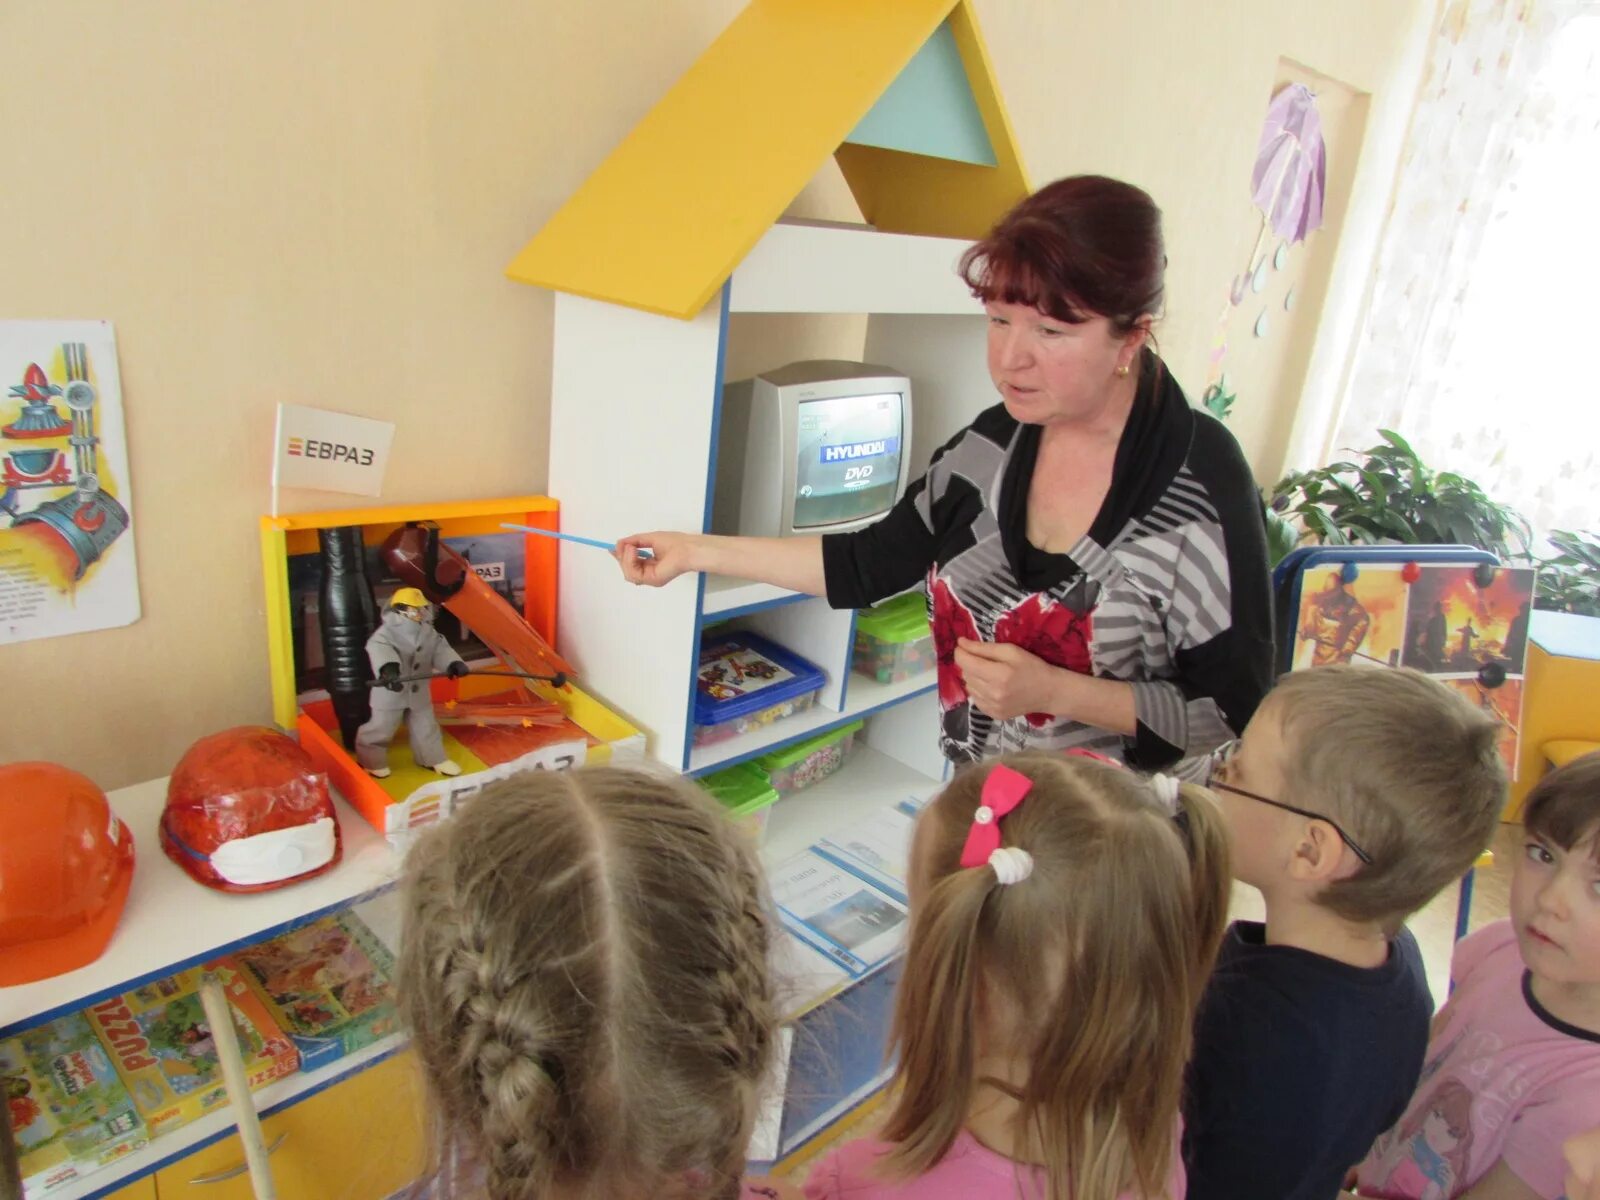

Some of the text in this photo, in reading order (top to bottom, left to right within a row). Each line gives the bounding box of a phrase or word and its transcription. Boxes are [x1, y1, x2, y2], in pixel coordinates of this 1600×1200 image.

[305, 439, 375, 466] ЕВРАЗ
[826, 440, 886, 461] HYUNDAI
[845, 465, 874, 480] DVD
[475, 566, 501, 578] РАЗ
